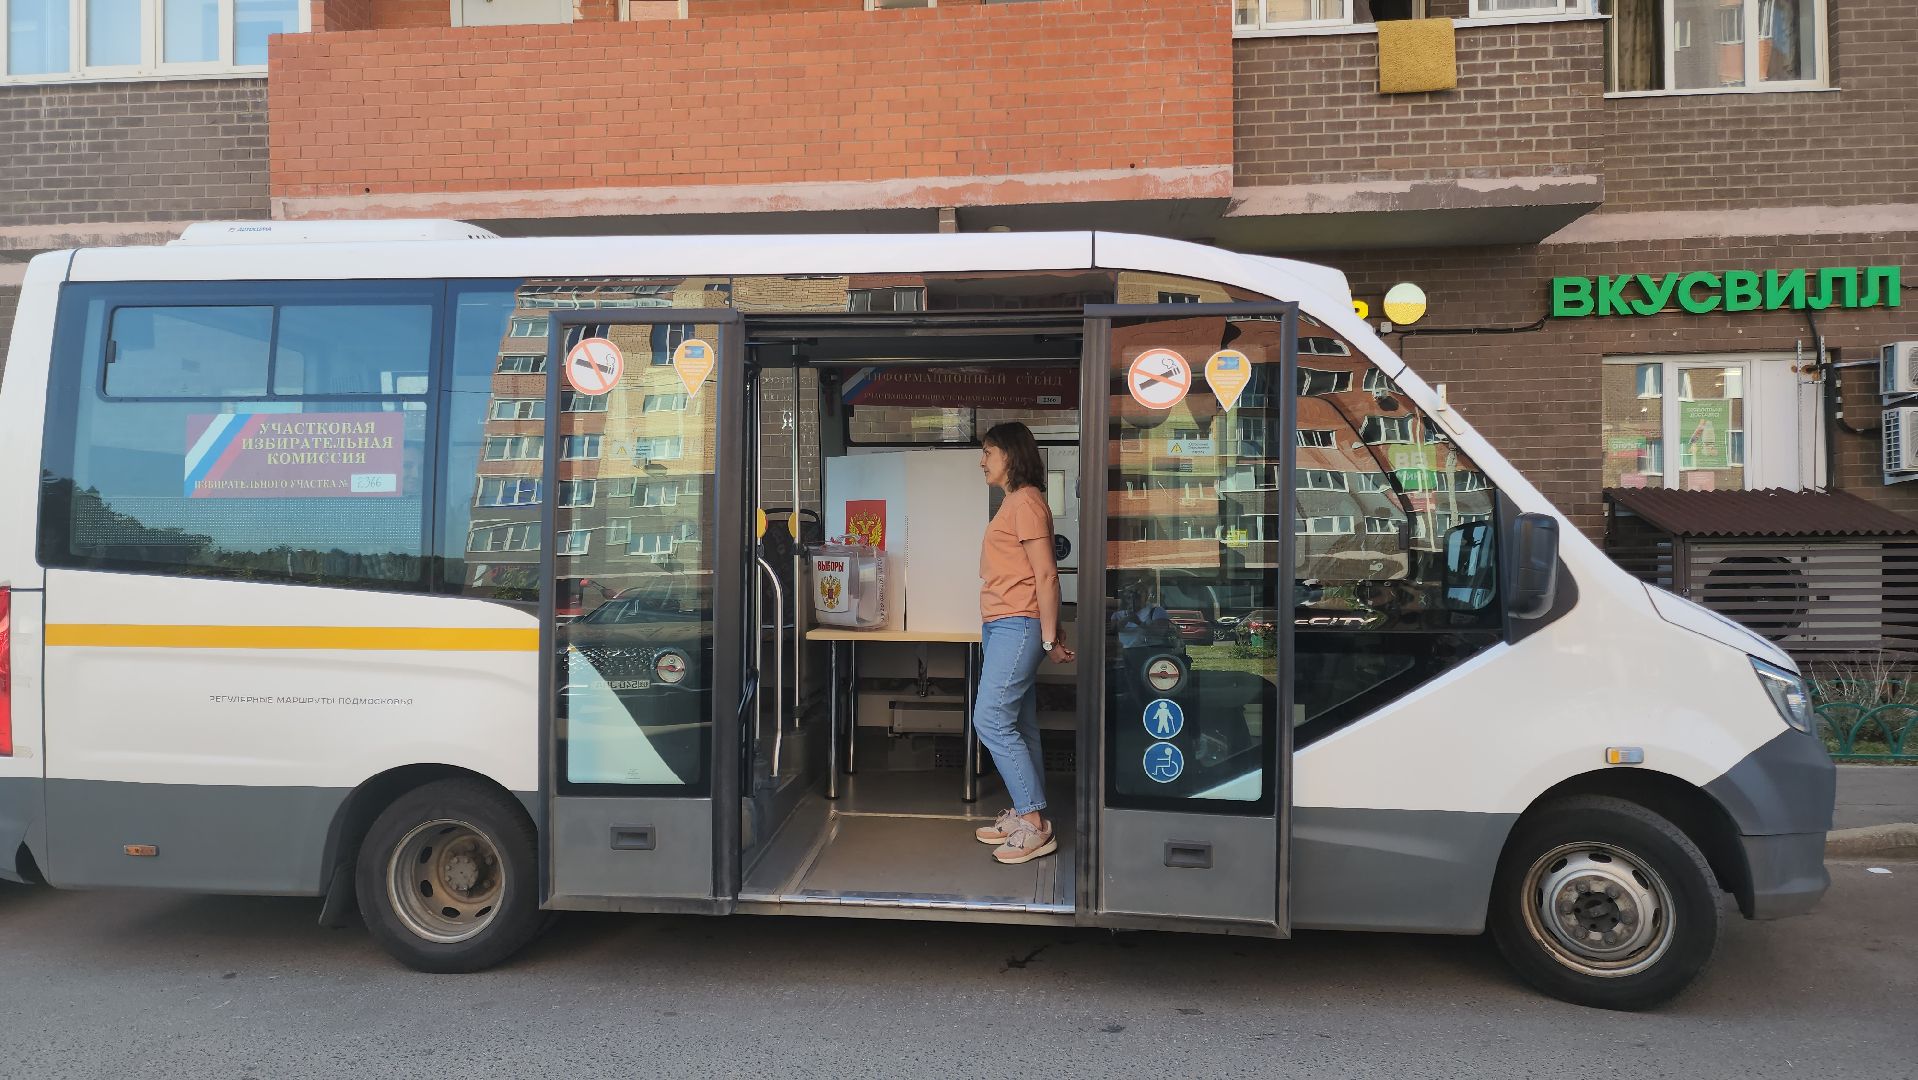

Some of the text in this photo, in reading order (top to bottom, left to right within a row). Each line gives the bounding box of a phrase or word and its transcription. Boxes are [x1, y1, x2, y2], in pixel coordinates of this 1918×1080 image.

[1553, 265, 1901, 317] ВКУСВИЛЛ
[1015, 373, 1063, 386] СТЕНД
[259, 421, 376, 436] УЧАСТКОВАЯ
[241, 437, 394, 450] ИЗБИРАТЕЛЬНАЯ
[267, 452, 367, 465] КОМИССИЯ
[194, 479, 288, 489] ИЗБИРАТЕЛЬНОГО
[290, 479, 336, 489] УЧАСТКА
[817, 560, 844, 573] ВЫБОРЫ
[276, 695, 335, 705] МАРШРУТЫ
